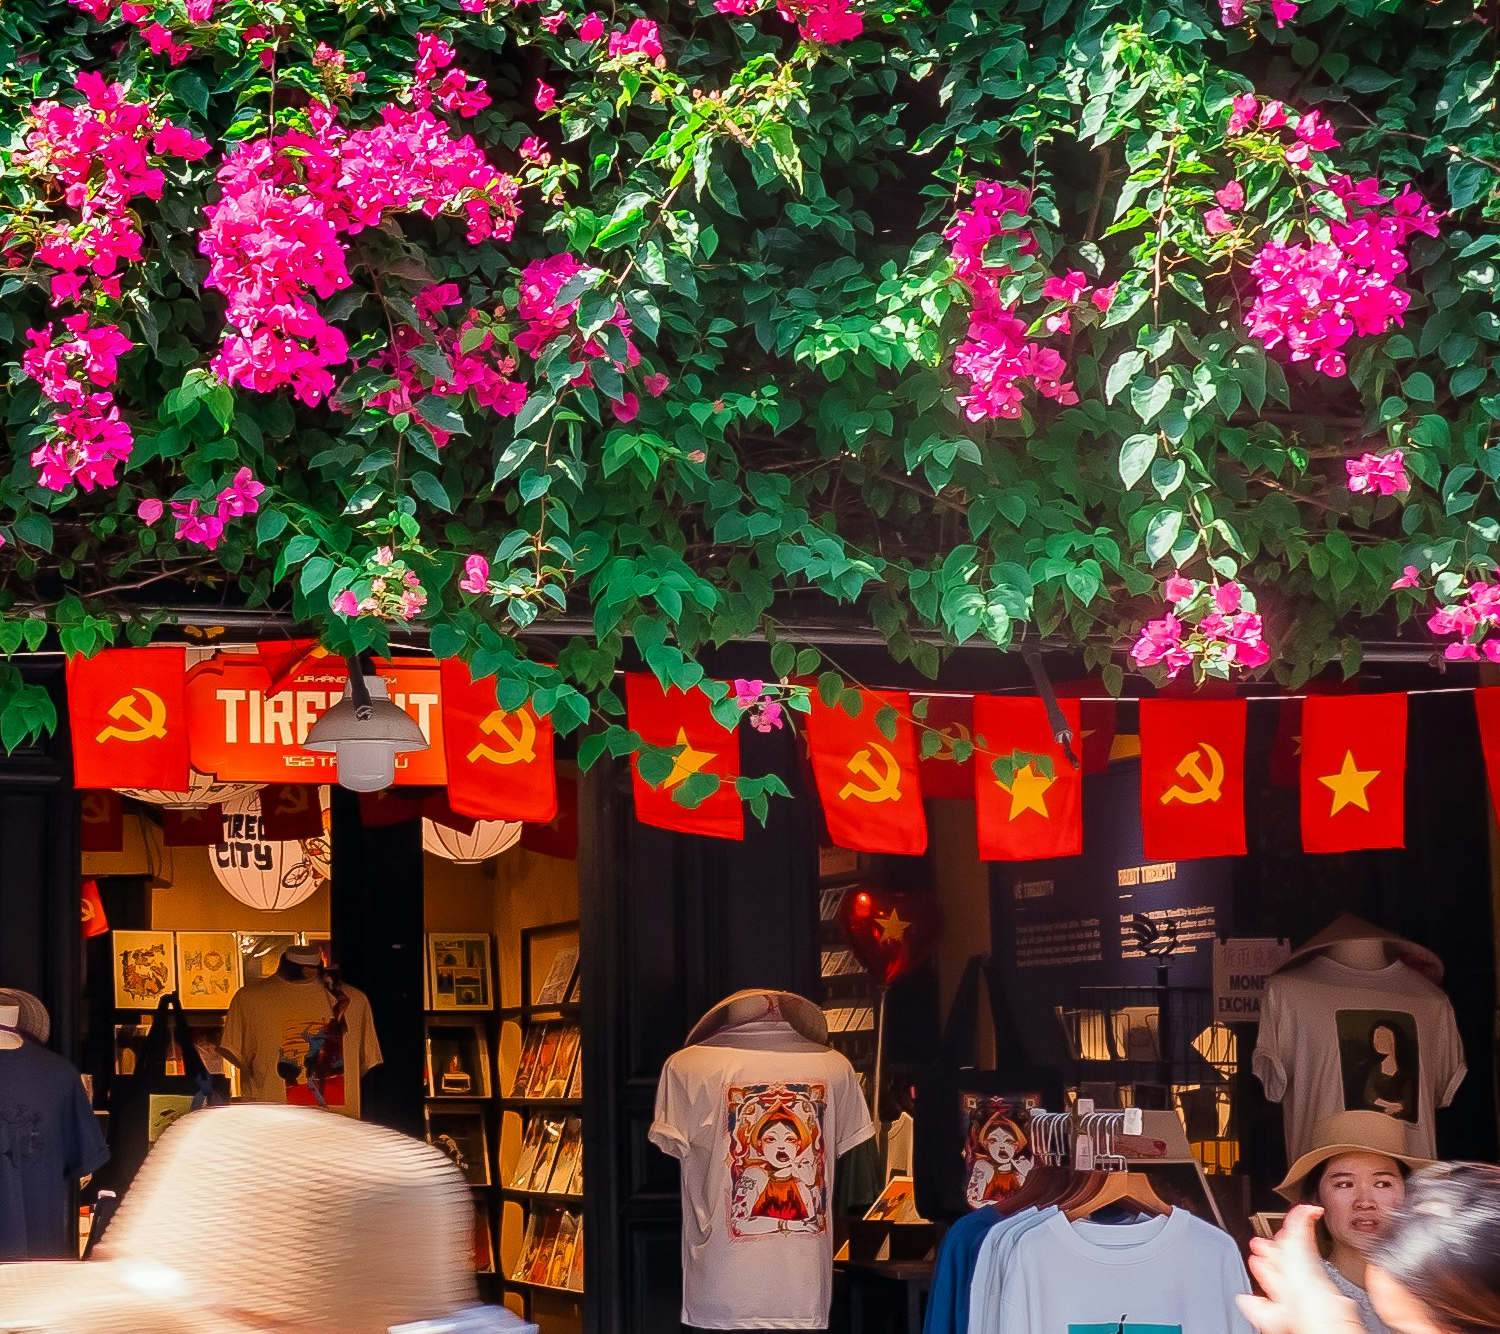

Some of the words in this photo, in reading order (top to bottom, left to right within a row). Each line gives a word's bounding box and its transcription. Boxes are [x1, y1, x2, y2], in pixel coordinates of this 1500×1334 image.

[282, 755, 315, 767] 152
[215, 842, 273, 871] CITY
[1229, 974, 1268, 990] MONE
[1218, 996, 1261, 1012] EXCHA
